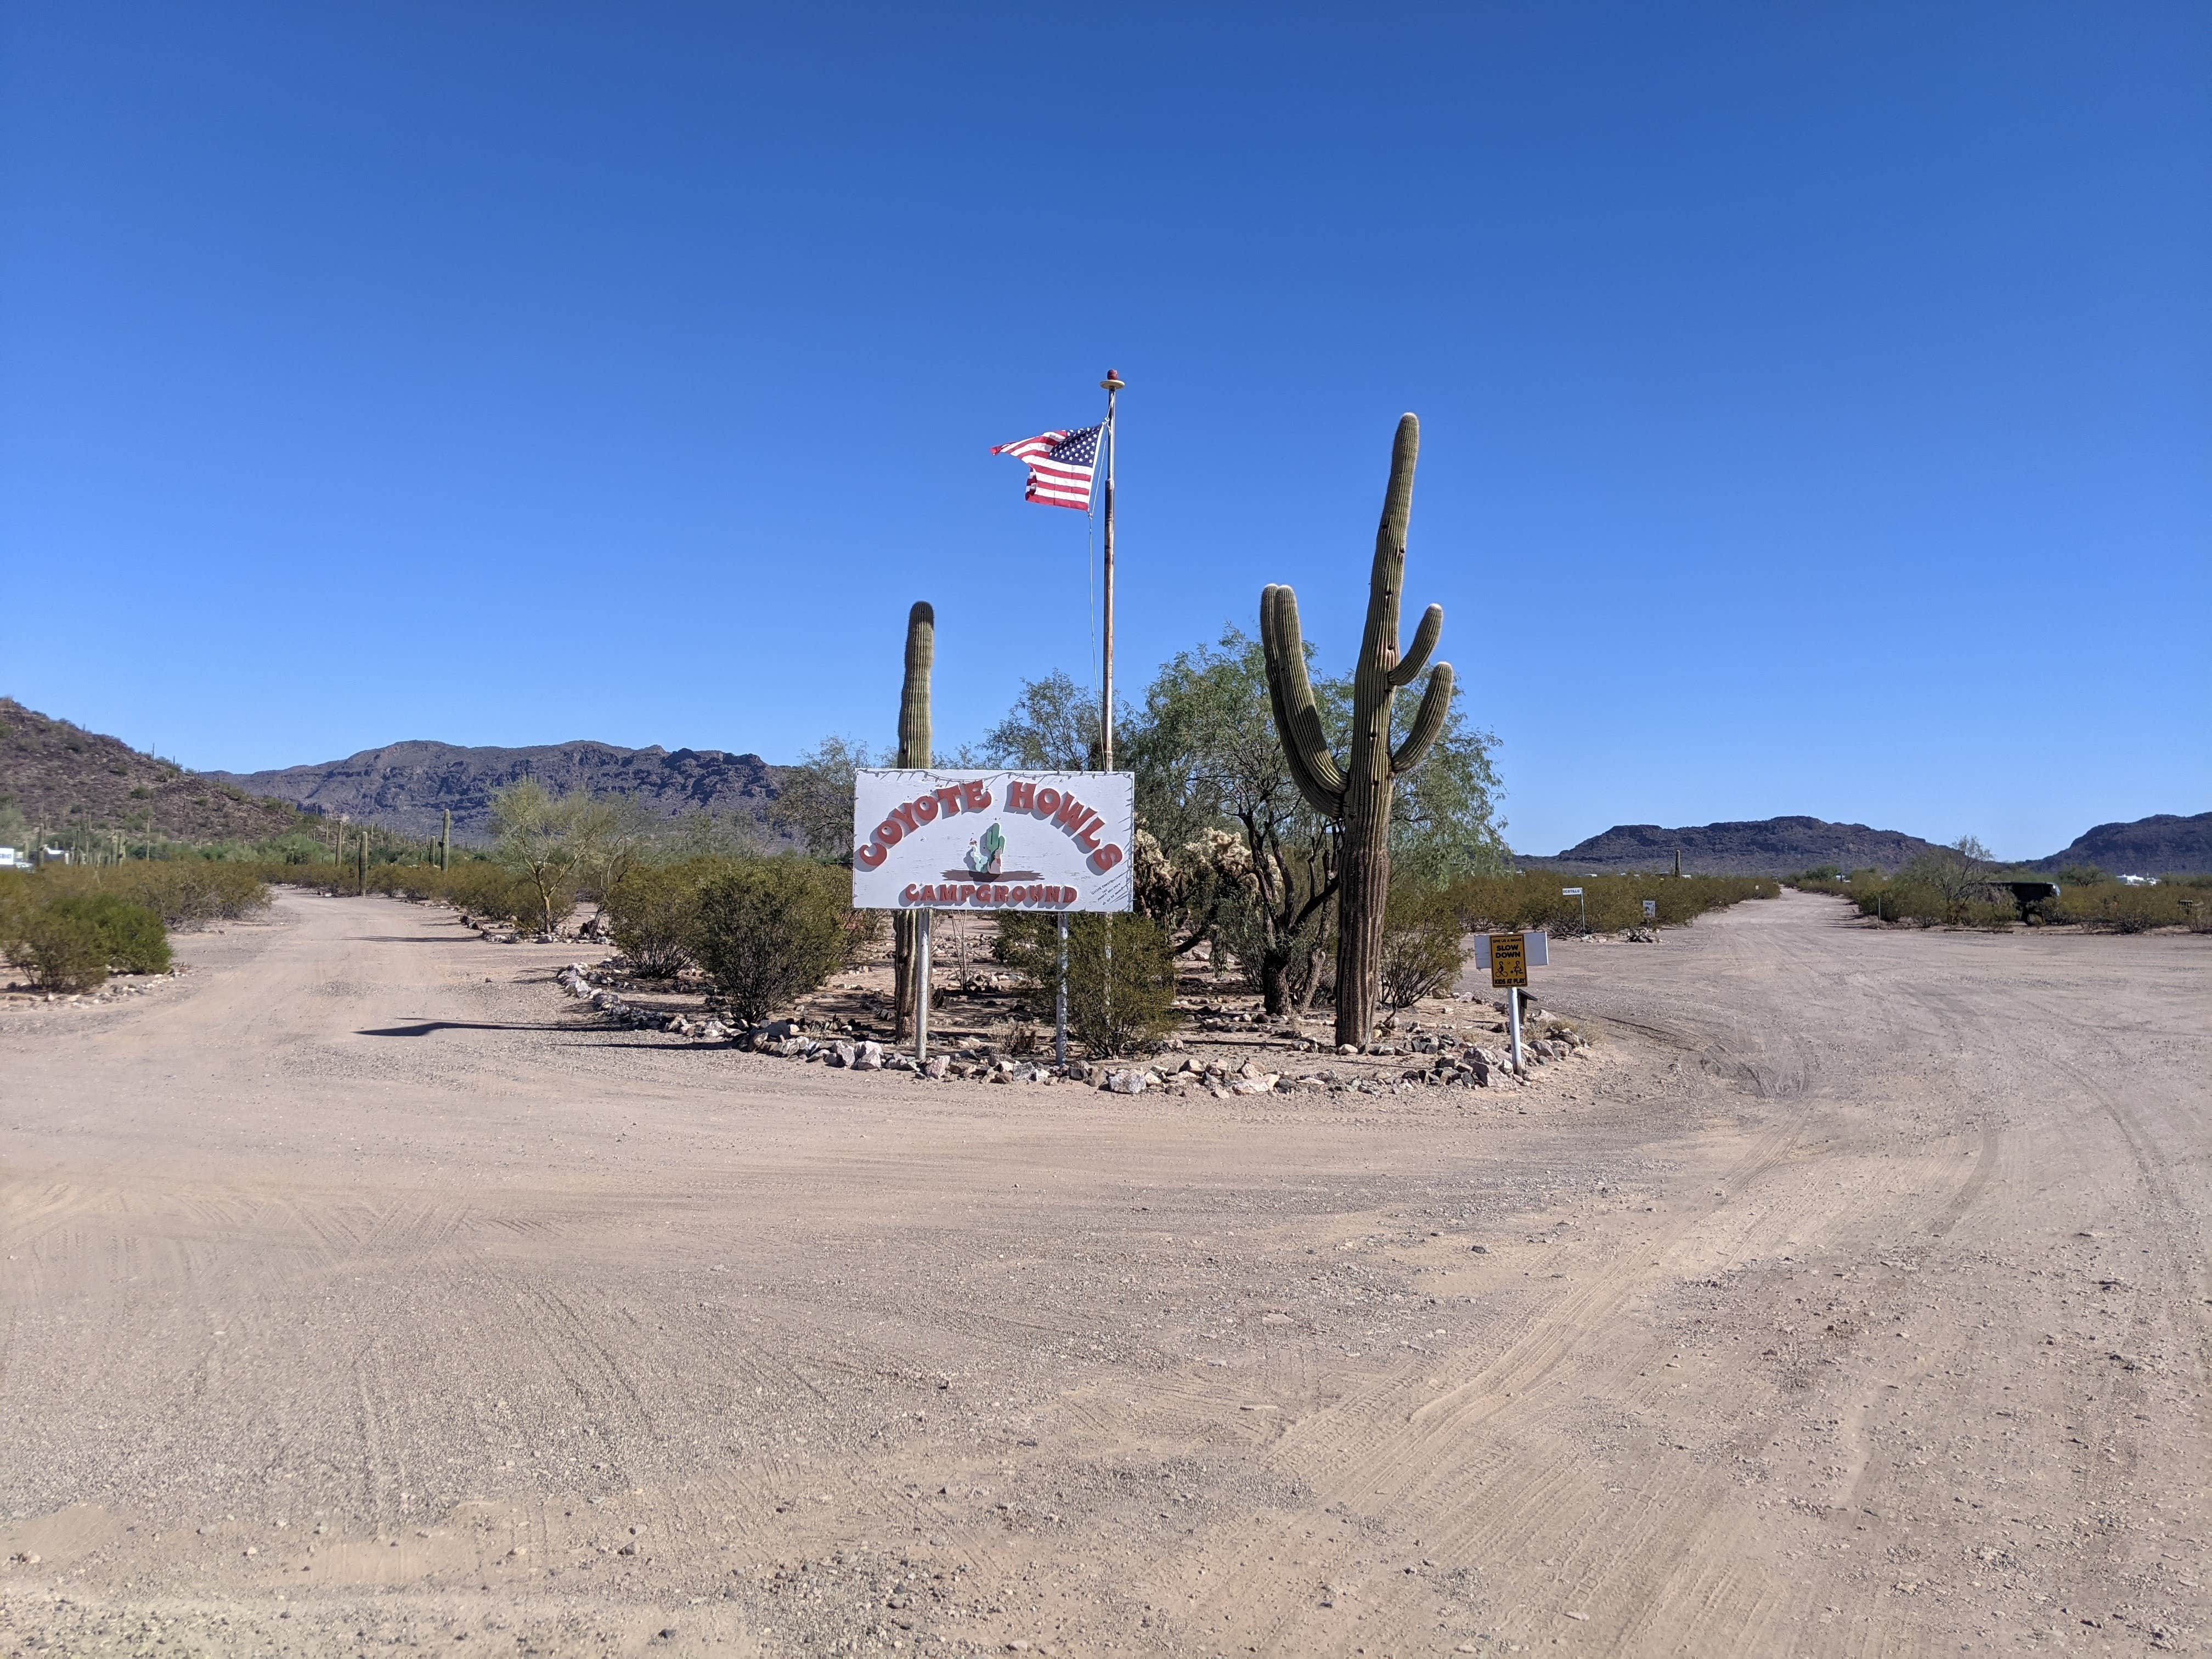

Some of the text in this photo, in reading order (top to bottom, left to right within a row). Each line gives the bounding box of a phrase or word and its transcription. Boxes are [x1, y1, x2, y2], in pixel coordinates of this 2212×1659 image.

[857, 779, 1123, 872] COYOTE HOWLS
[903, 883, 1077, 905] CAMPGROUND
